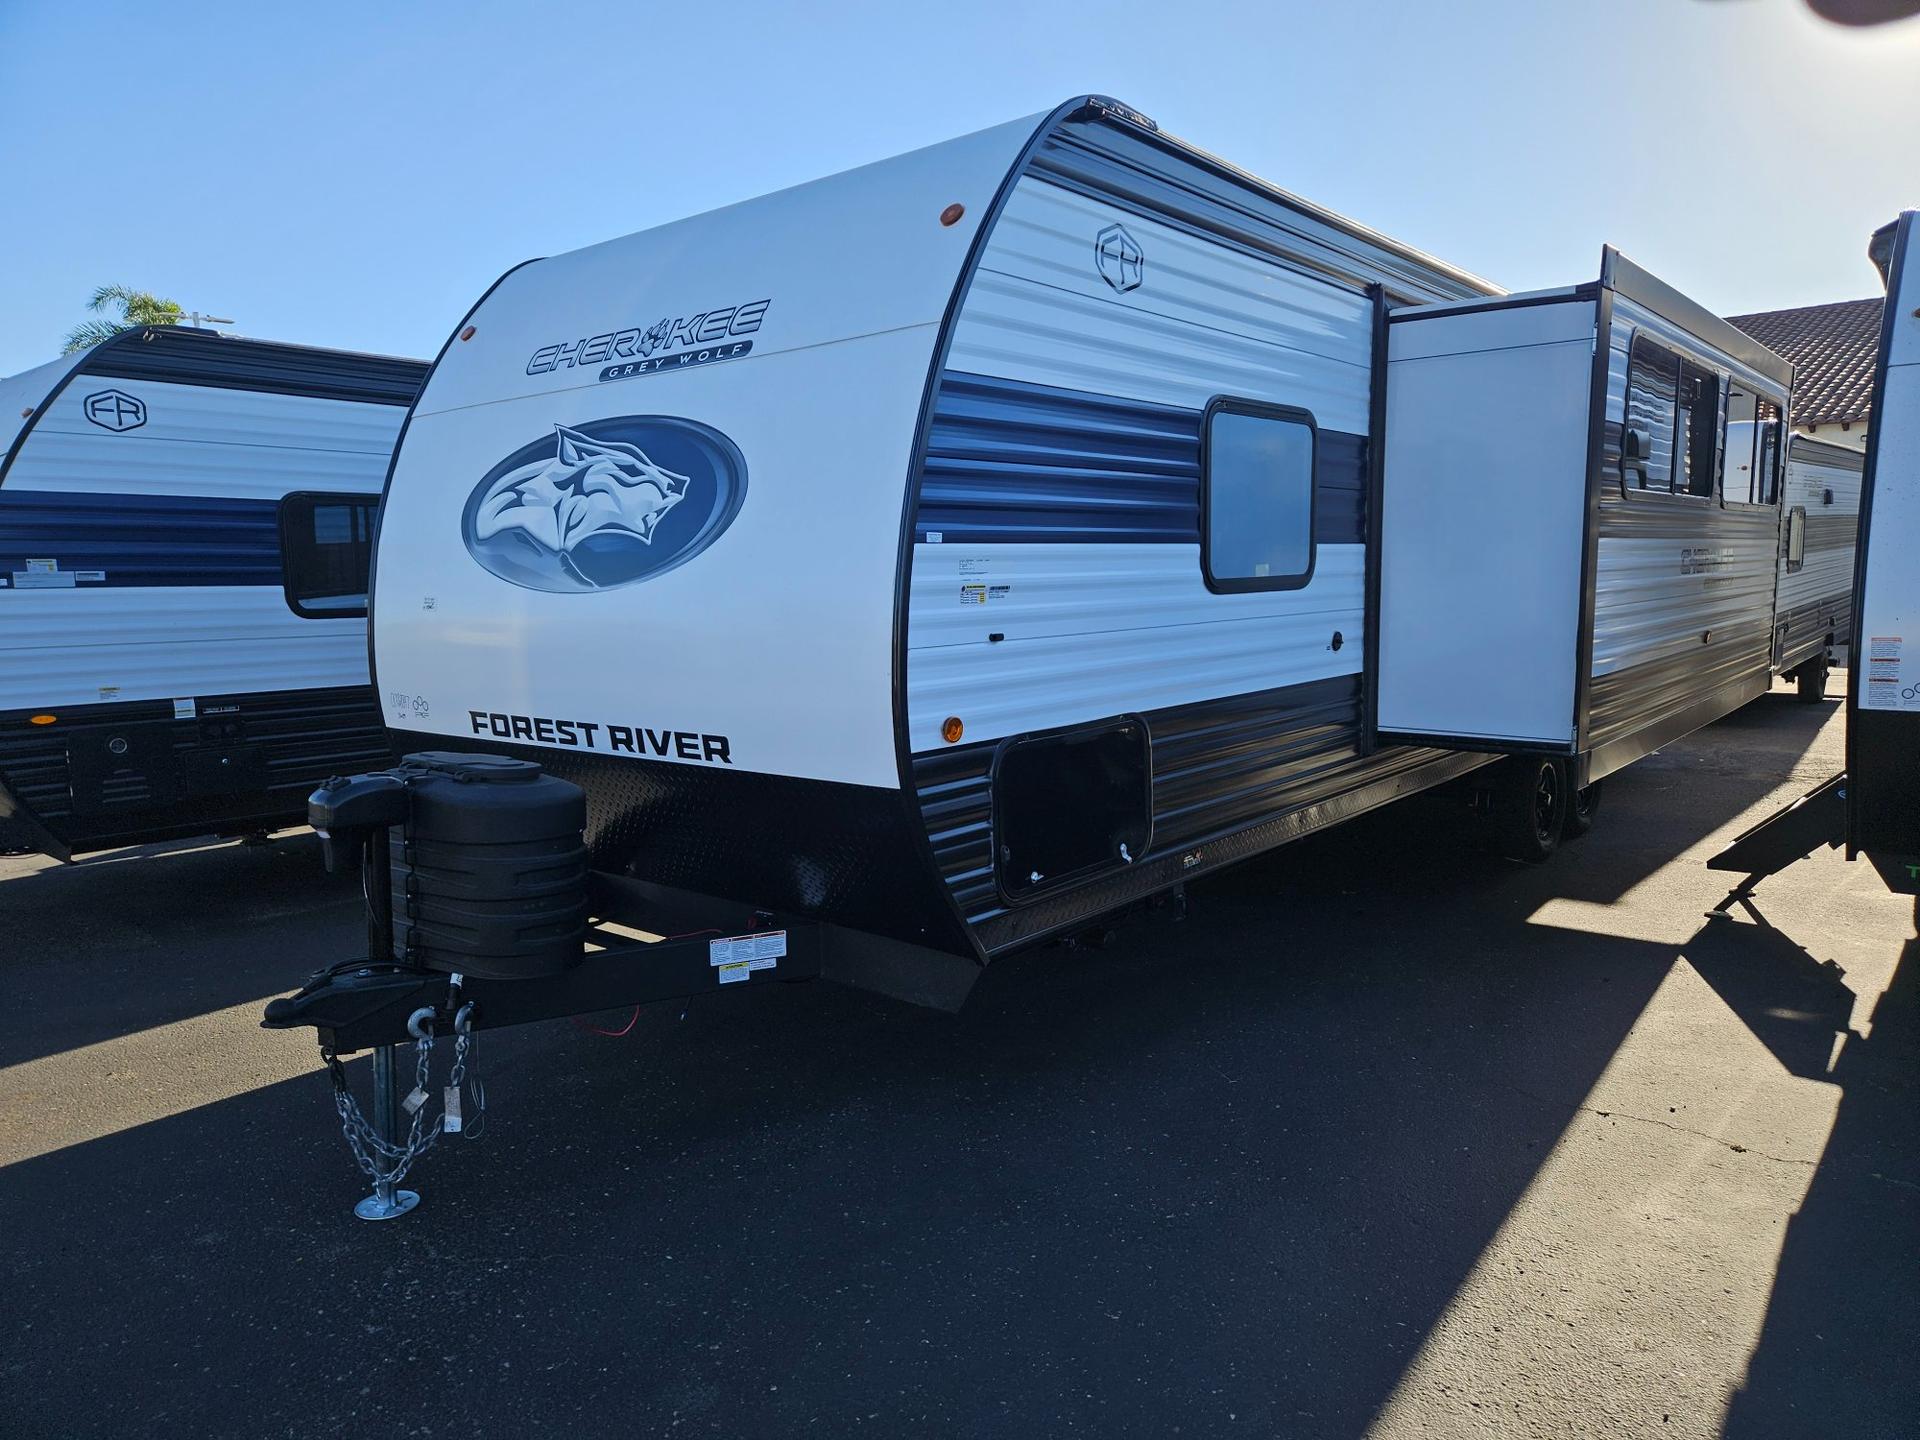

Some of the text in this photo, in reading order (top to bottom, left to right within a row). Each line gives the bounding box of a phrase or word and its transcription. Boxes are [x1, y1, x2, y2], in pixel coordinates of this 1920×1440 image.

[608, 344, 743, 378] GREY WOLF
[468, 710, 732, 764] FOREST RIVER
